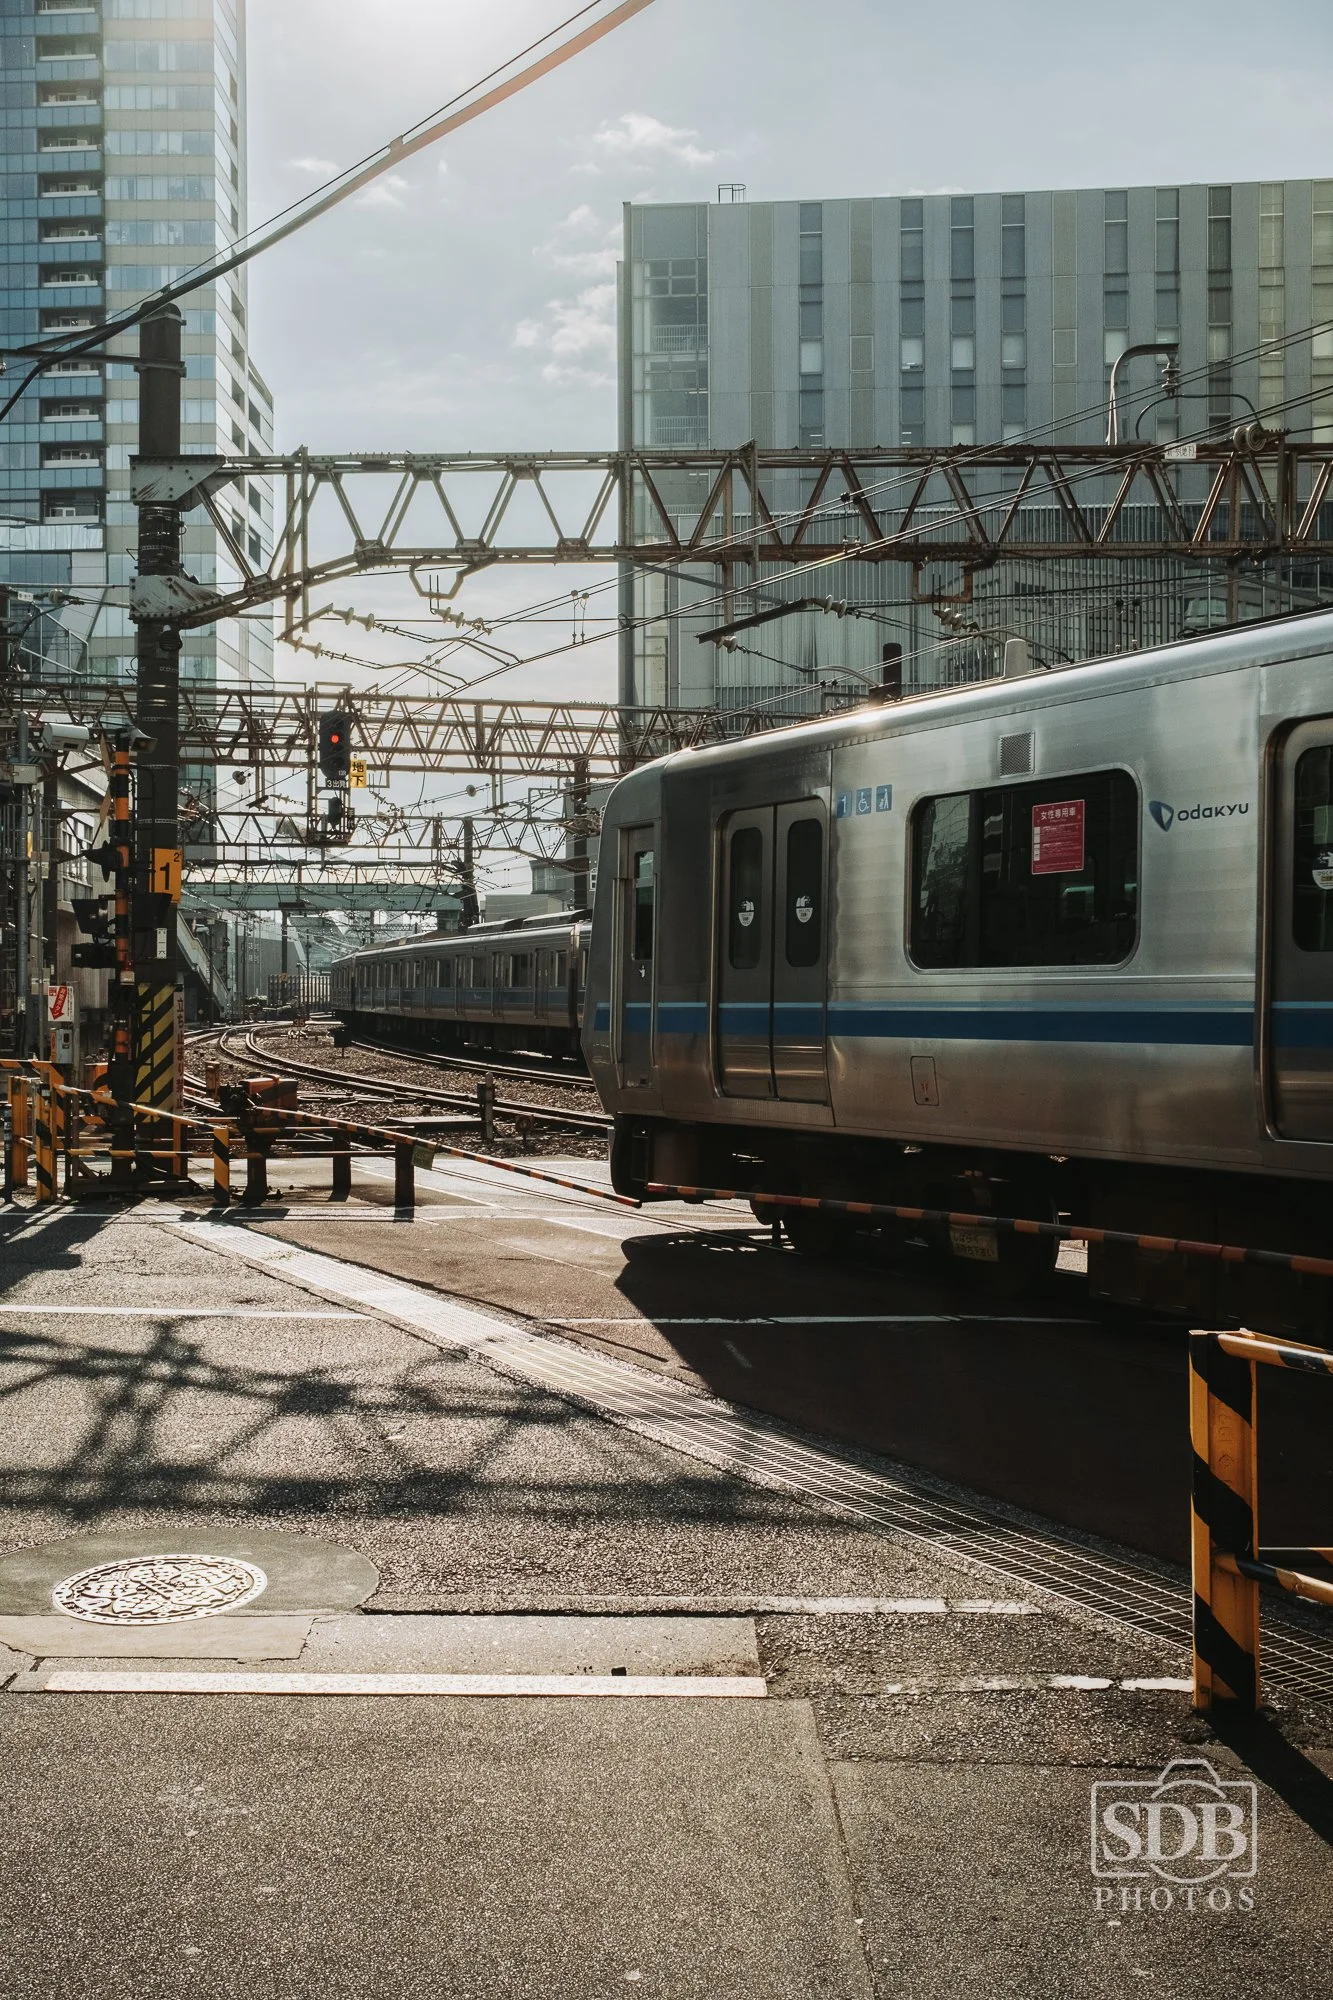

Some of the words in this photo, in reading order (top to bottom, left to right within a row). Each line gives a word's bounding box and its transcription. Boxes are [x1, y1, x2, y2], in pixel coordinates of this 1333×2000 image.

[352, 761, 364, 786] 地下
[841, 795, 846, 813] 1
[1040, 806, 1077, 821] 女性専用車
[160, 862, 170, 890] 1
[176, 997, 184, 1109] 立ち止まり禁止
